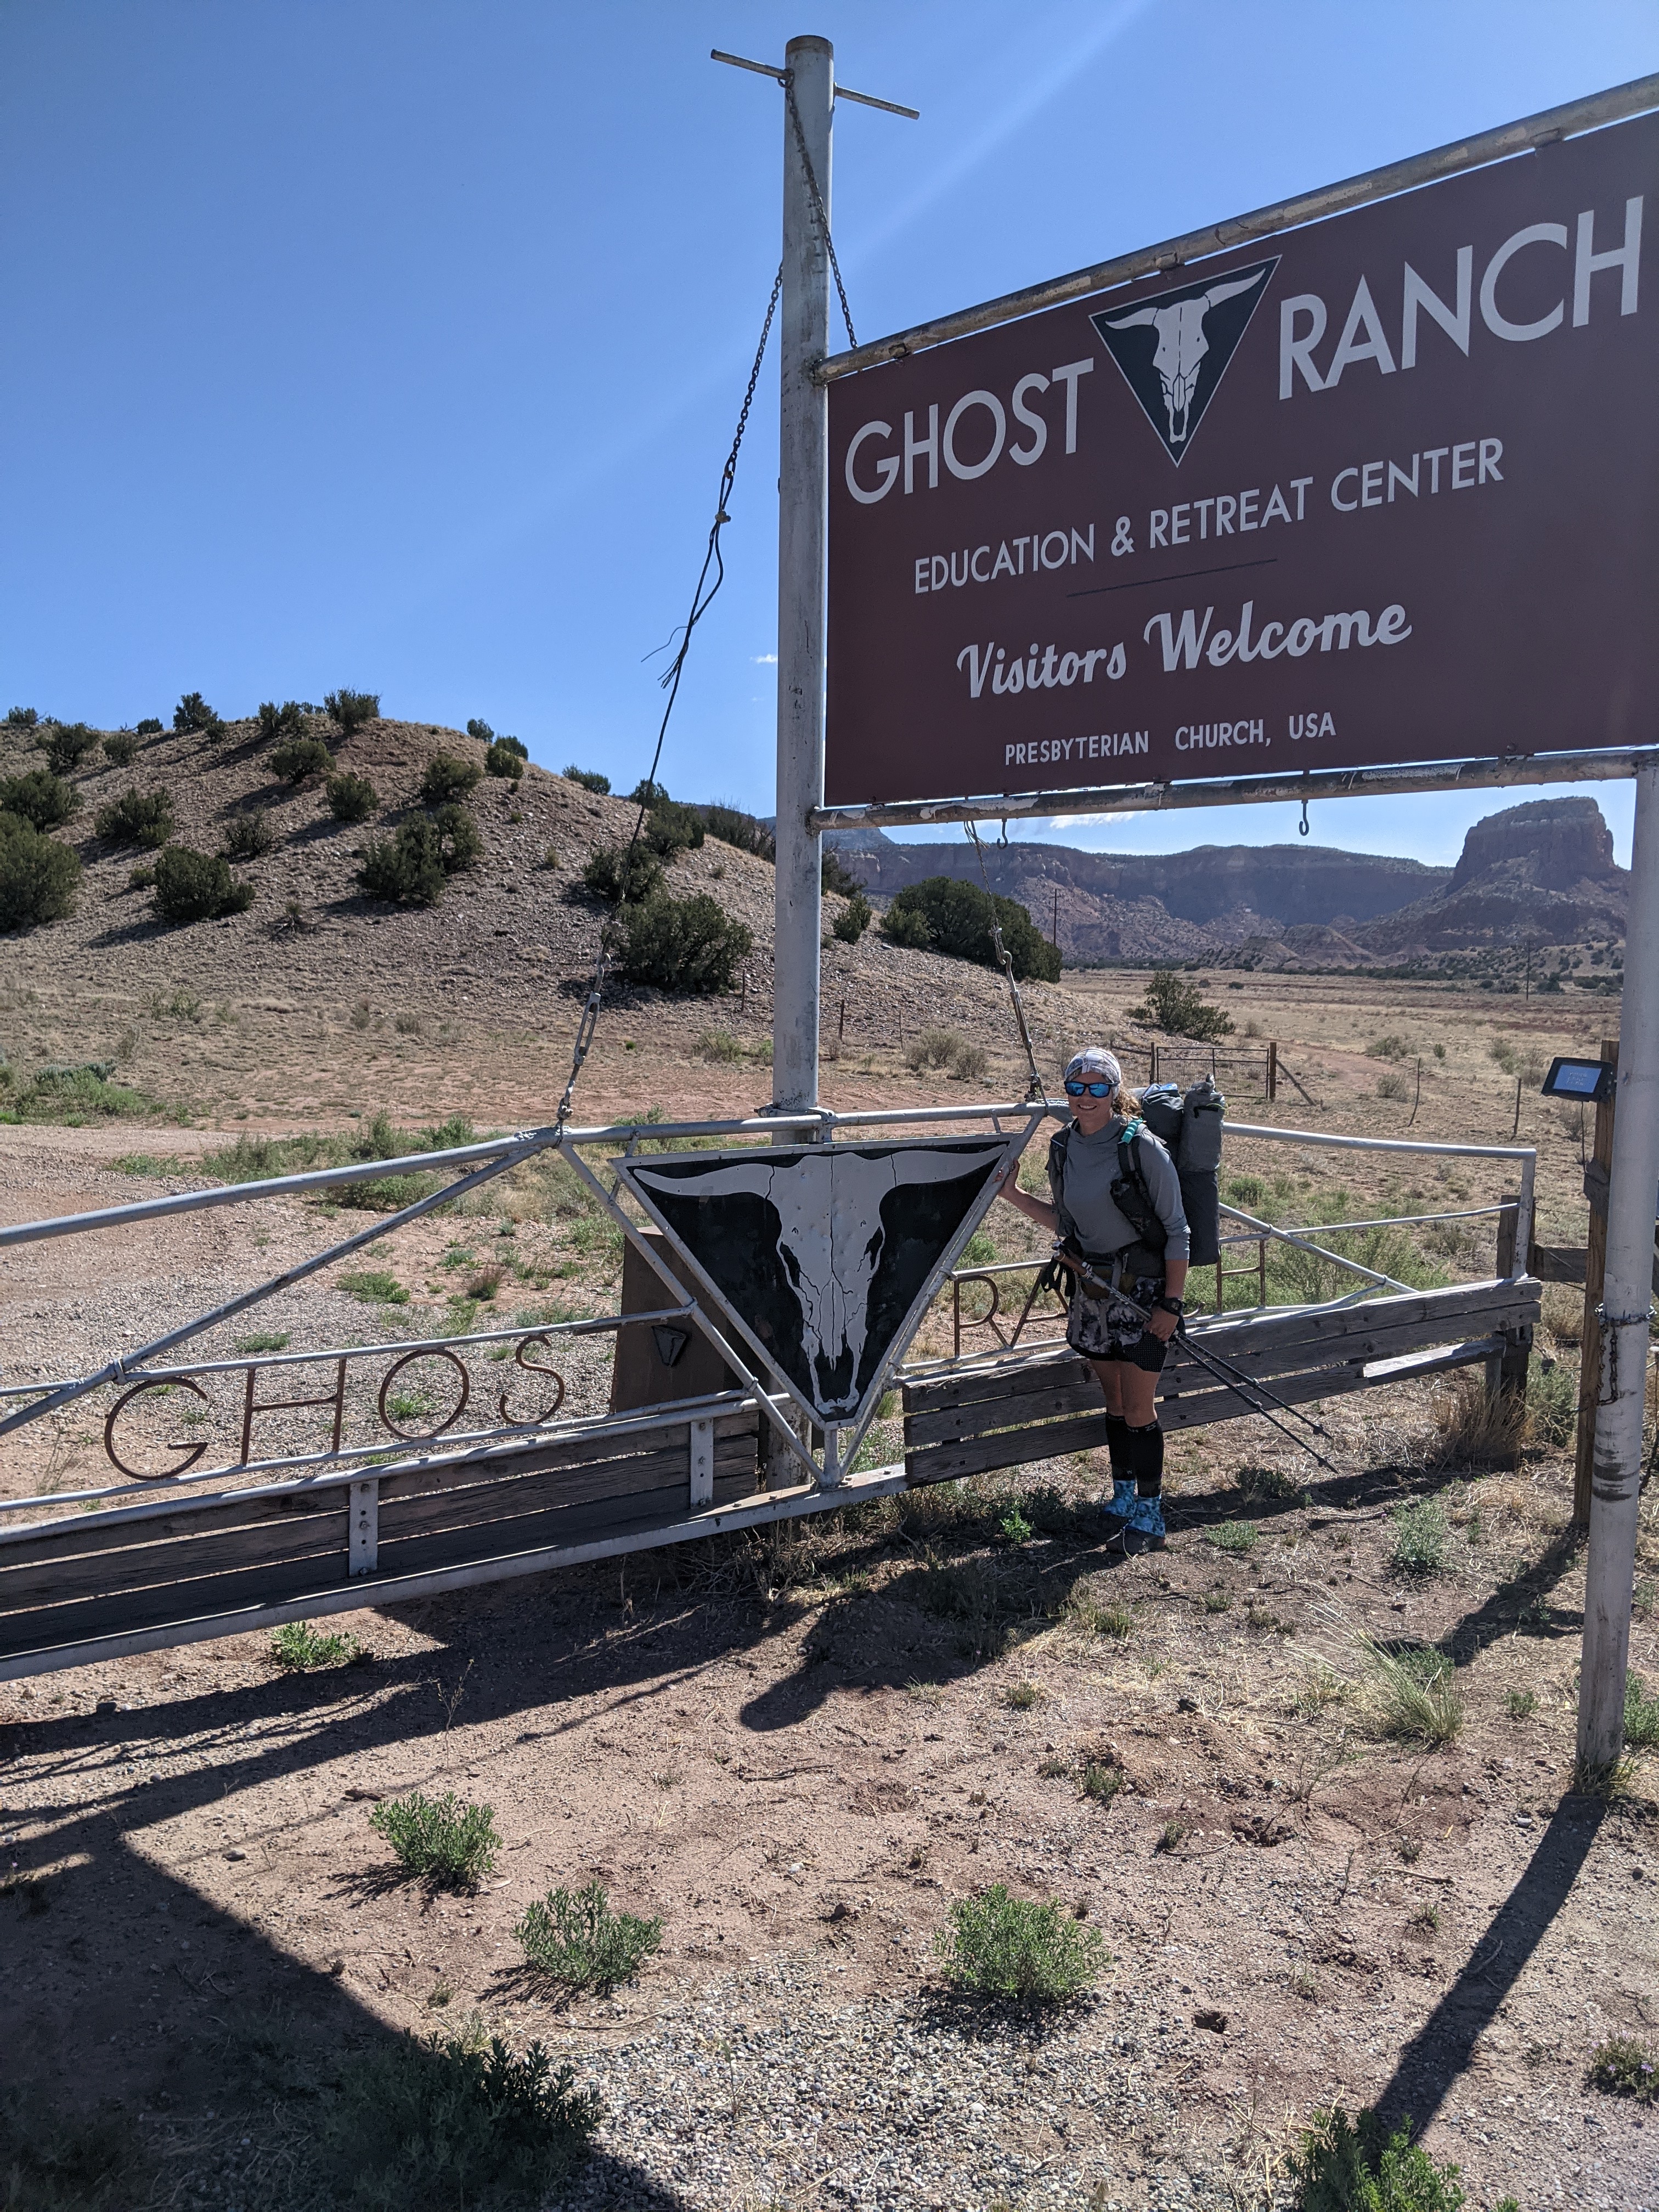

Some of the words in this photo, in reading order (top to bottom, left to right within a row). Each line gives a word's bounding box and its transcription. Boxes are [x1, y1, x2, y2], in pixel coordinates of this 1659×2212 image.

[845, 358, 1094, 504] GHOST
[1279, 195, 1644, 400] RANCH
[915, 523, 1094, 594] EDUCATION
[1111, 516, 1135, 556] &
[1150, 476, 1313, 549] RETREAT
[1331, 438, 1504, 511] CENTER
[957, 642, 1126, 698] Visitors
[1143, 600, 1413, 673] Welcome
[1005, 731, 1149, 766] PRESBYTERIAN
[1175, 719, 1271, 751] CHURCH,
[1289, 712, 1336, 740] USA
